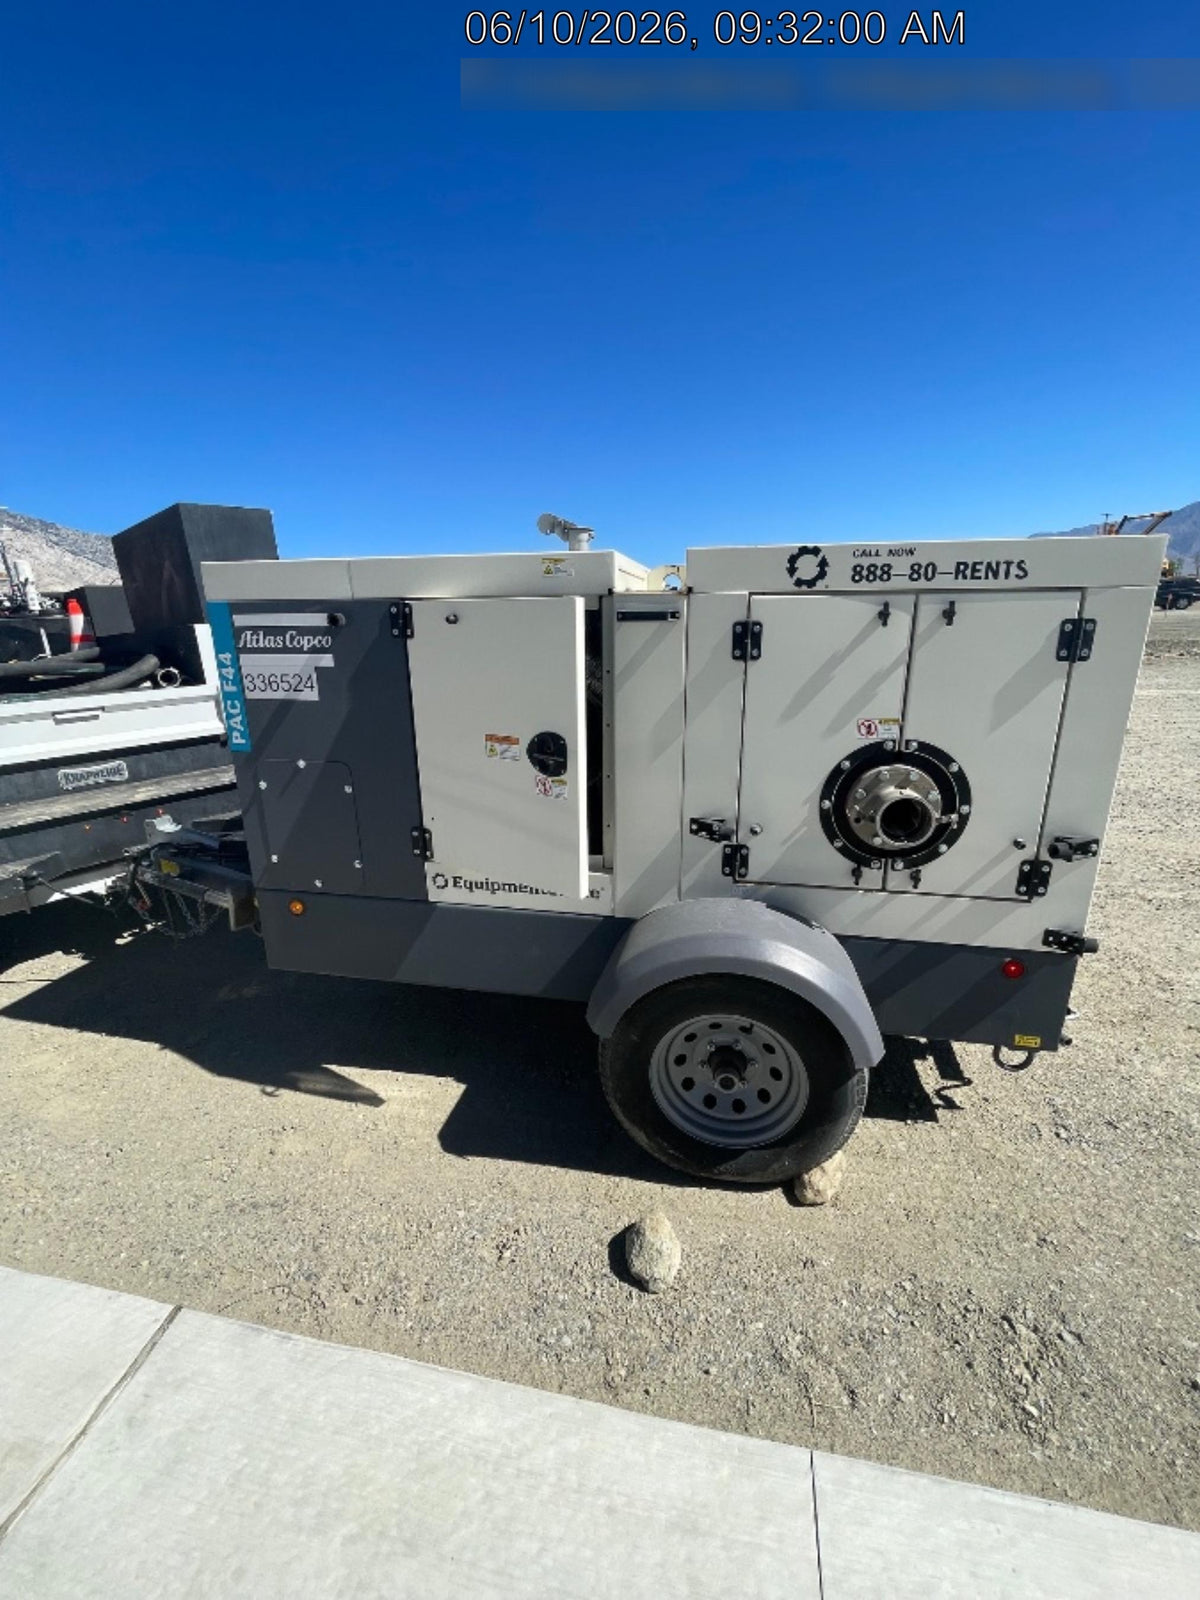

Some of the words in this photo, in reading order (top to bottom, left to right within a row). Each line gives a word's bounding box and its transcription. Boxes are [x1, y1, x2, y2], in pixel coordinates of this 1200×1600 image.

[852, 548, 881, 558] CALL
[887, 547, 917, 558] NOW
[851, 560, 1029, 583] 888-80-RENTS
[238, 630, 283, 648] Atlas
[286, 631, 332, 651] Copco
[218, 653, 236, 692] F44
[244, 673, 315, 693] 336524
[228, 700, 246, 744] PAC
